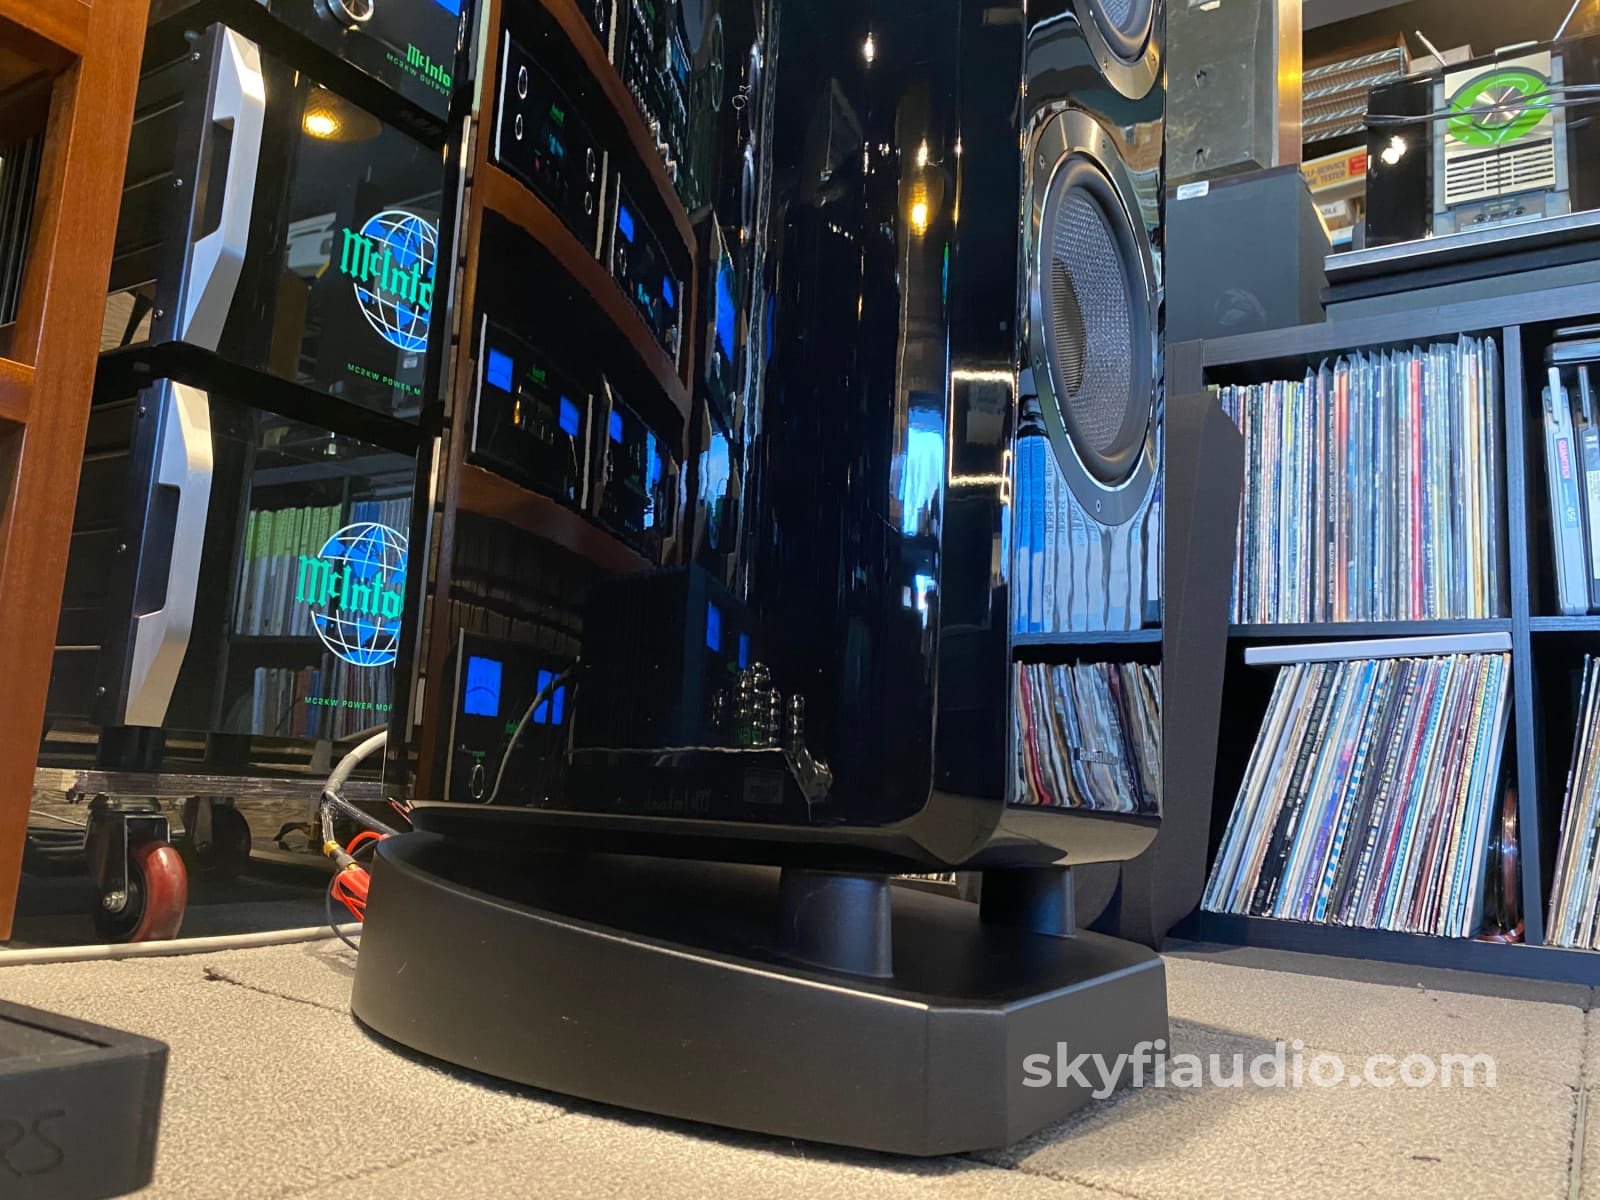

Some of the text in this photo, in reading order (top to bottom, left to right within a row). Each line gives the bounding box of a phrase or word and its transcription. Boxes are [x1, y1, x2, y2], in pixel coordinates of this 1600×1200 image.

[382, 376, 411, 393] POWER
[304, 696, 339, 708] MC2KW
[342, 699, 372, 710] POWER
